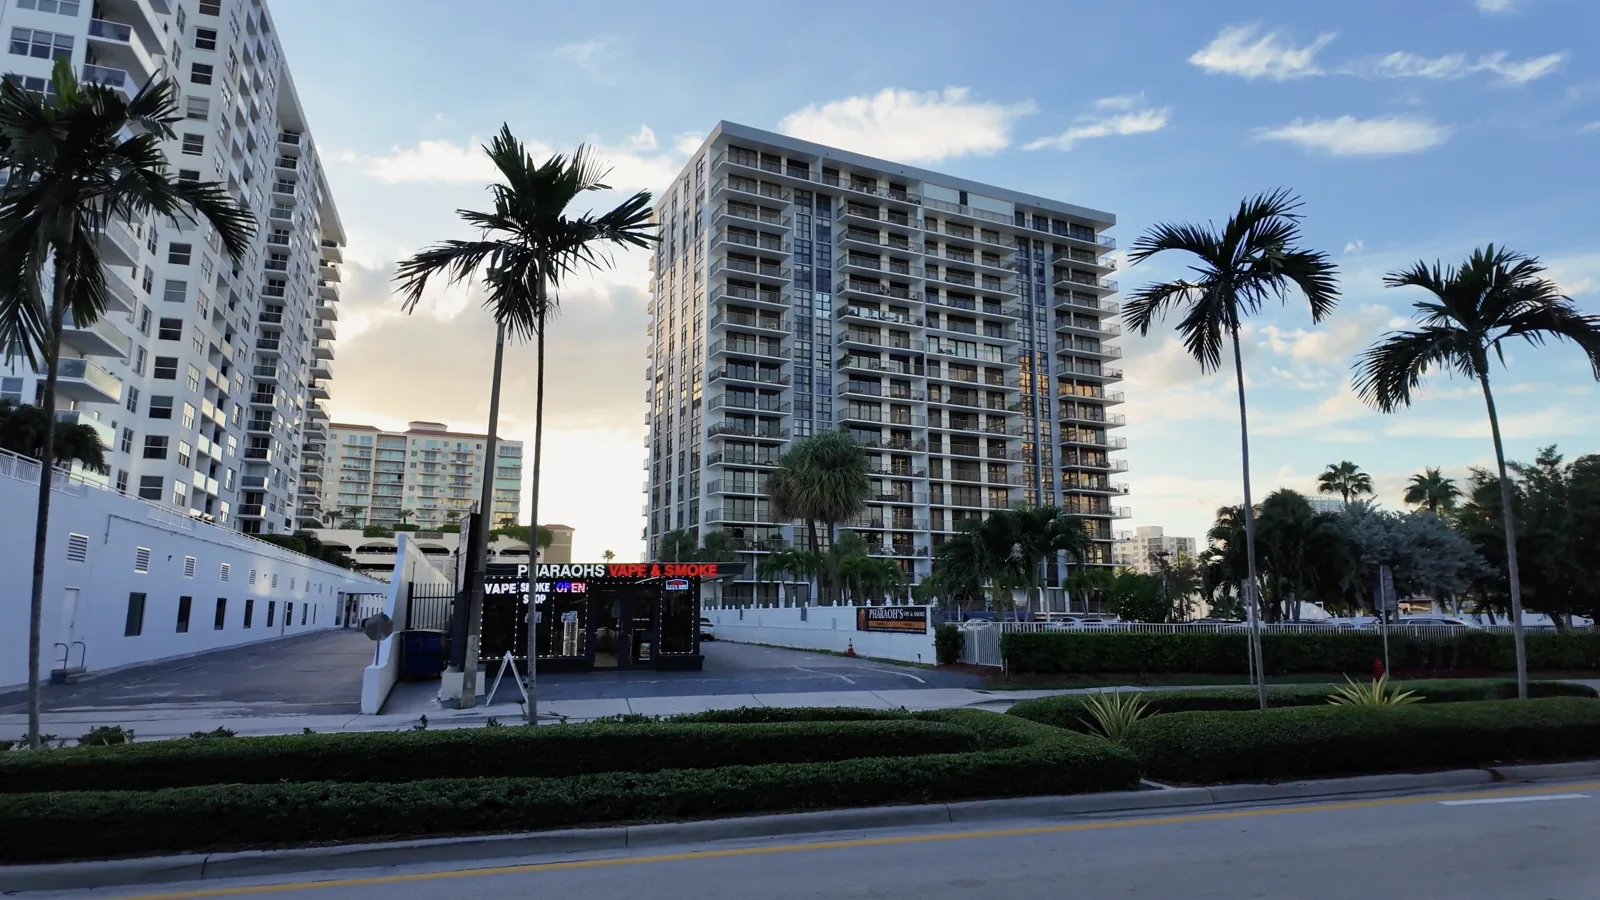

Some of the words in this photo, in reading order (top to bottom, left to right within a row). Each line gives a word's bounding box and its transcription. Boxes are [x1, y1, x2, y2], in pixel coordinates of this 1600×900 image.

[608, 564, 647, 577] VAPE
[651, 564, 660, 577] &
[664, 564, 718, 577] SMOKE
[484, 583, 517, 594] VAPE
[556, 583, 585, 593] OPEN
[523, 594, 546, 604] SOP
[869, 608, 903, 619] PHARAOH'S
